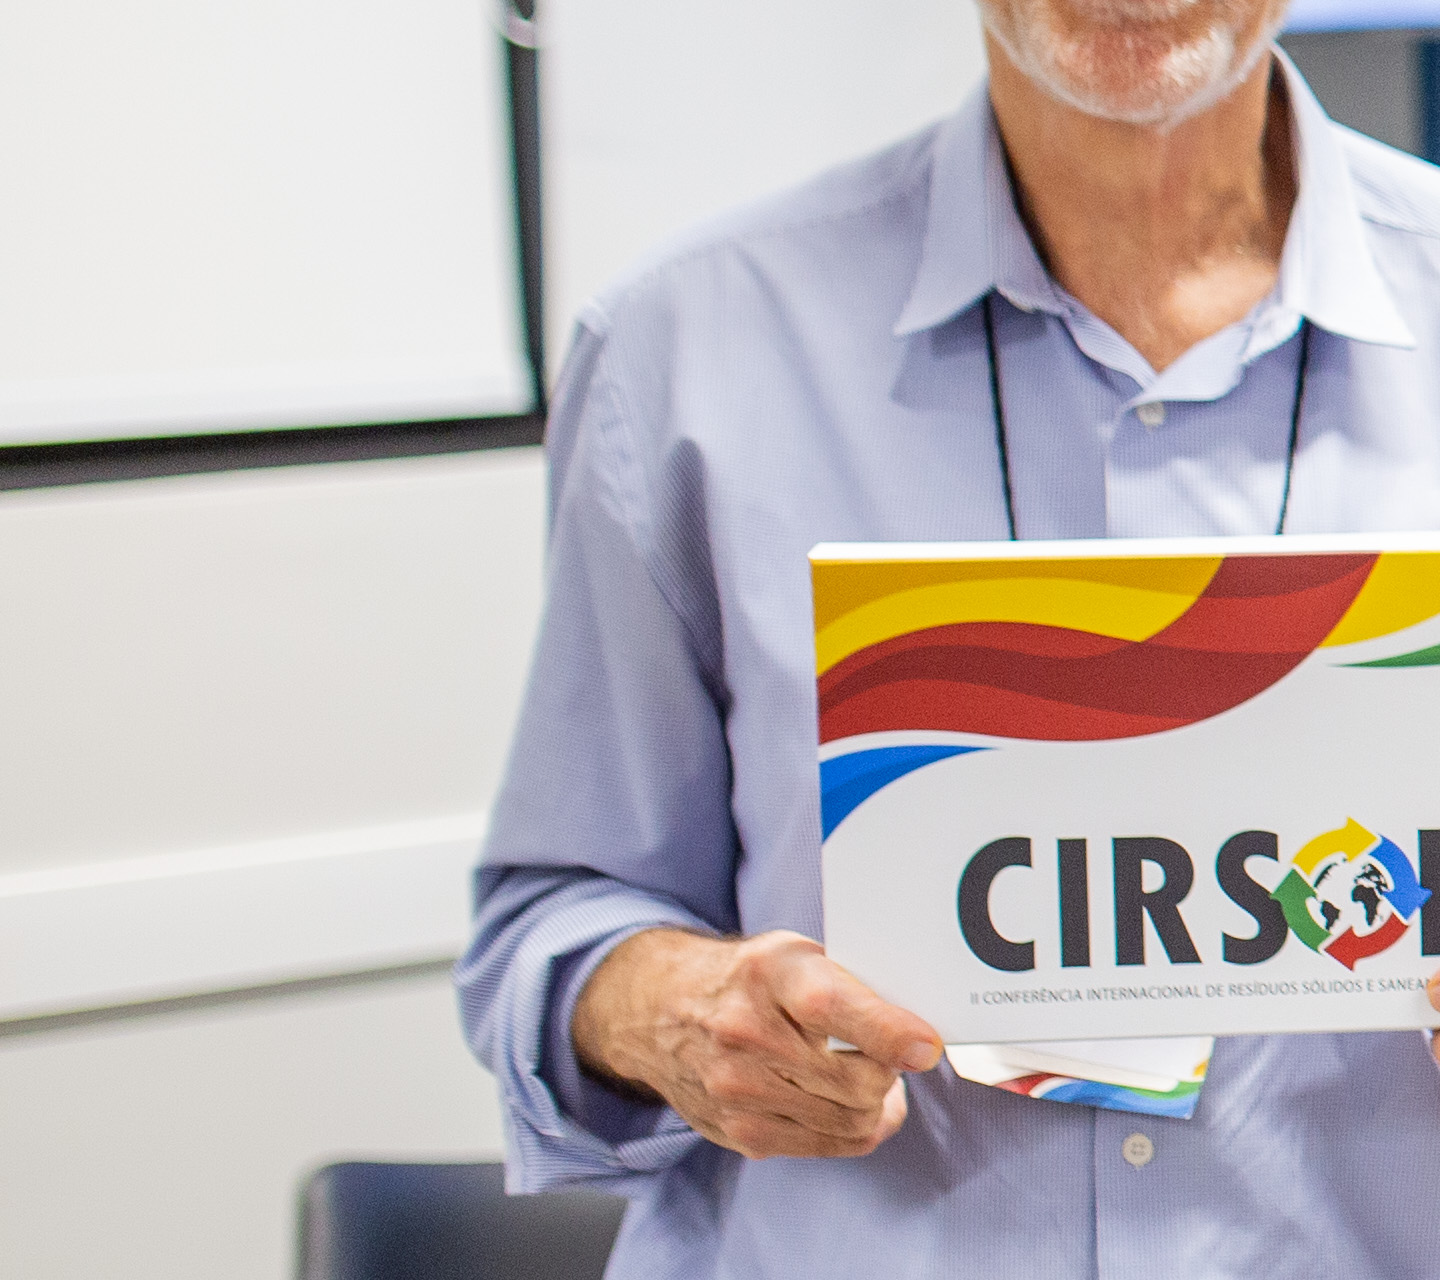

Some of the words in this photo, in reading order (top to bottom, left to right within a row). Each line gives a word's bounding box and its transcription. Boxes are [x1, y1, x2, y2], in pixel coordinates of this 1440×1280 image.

[970, 990, 980, 1005] II
[982, 987, 1083, 1005] CONFERÊNCIA
[1087, 984, 1201, 1002] INTERNACIONAL
[1206, 983, 1224, 998] DE
[1228, 978, 1298, 997] RESÍDUOS
[1302, 976, 1363, 994] SÓLIDOS
[1367, 978, 1375, 993] E
